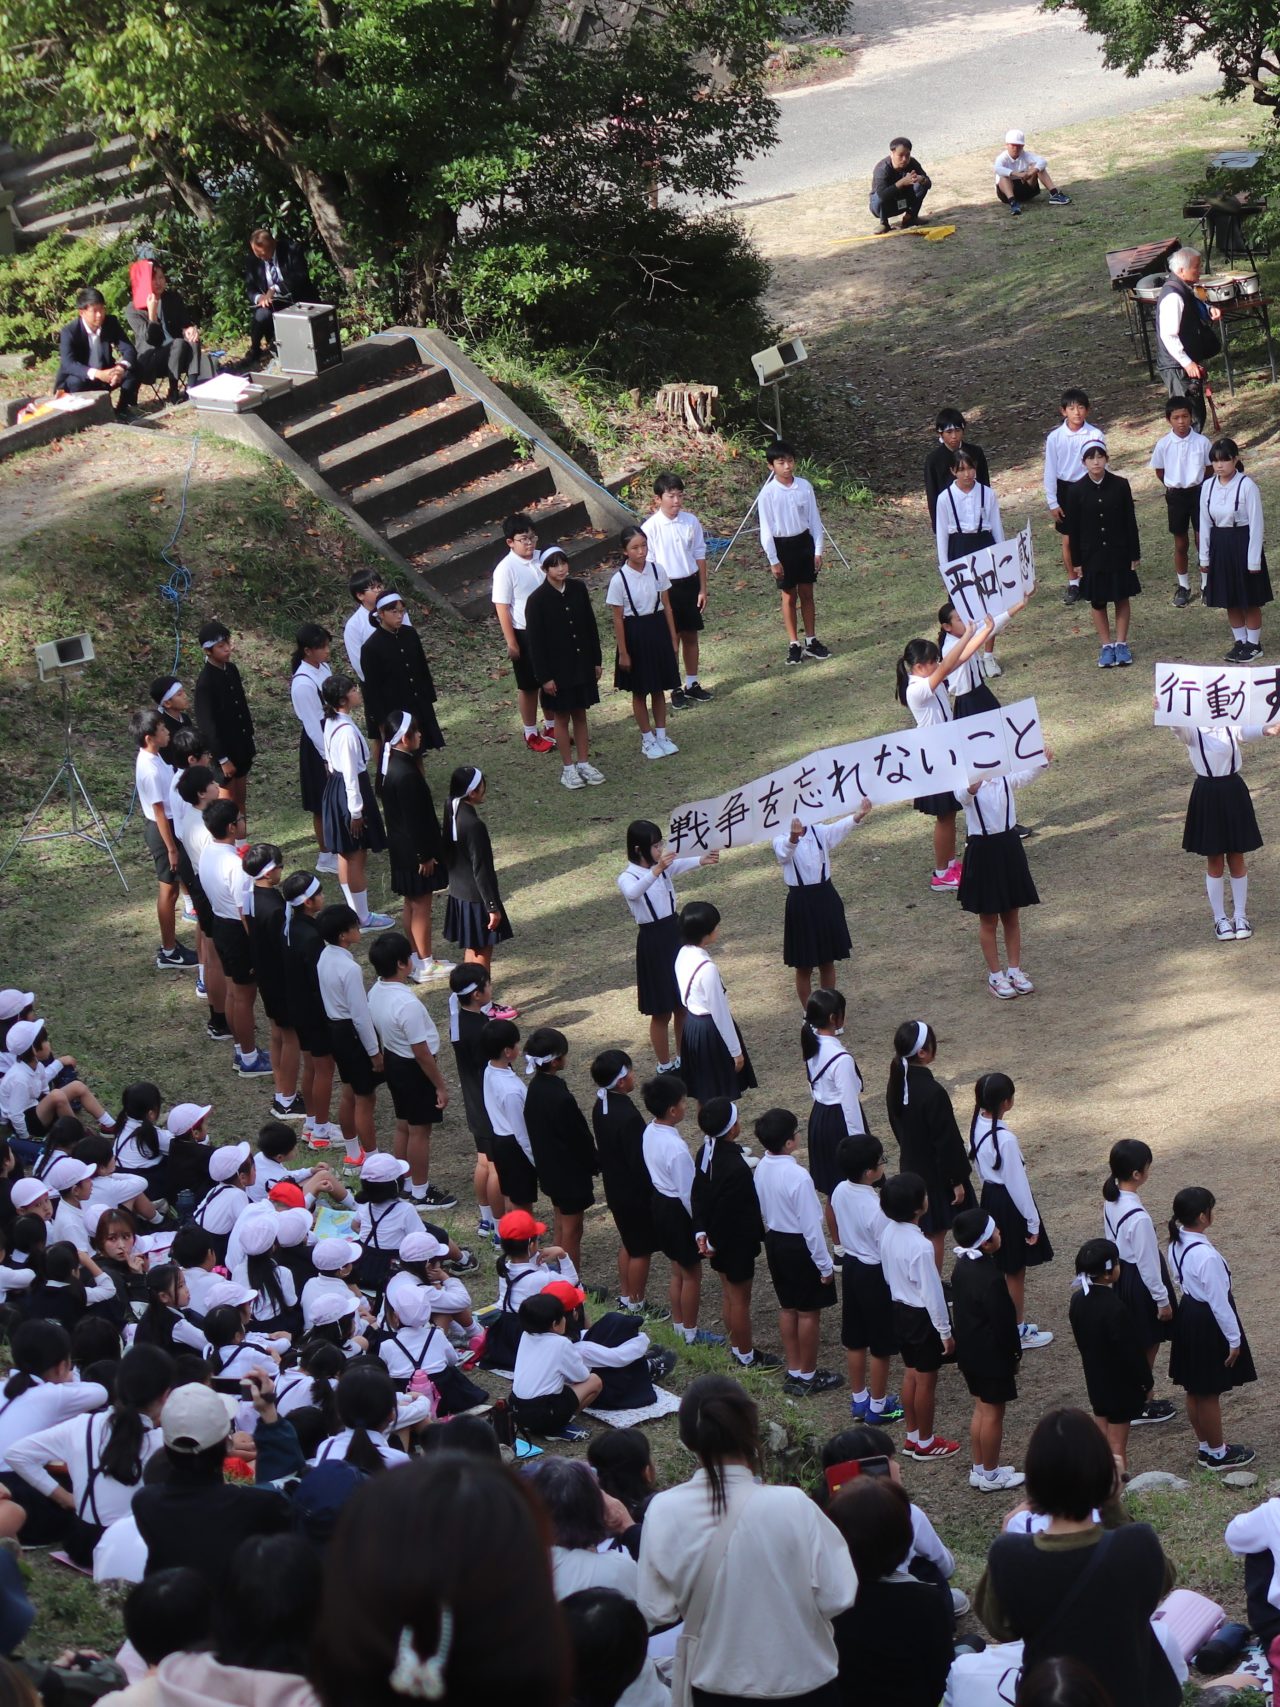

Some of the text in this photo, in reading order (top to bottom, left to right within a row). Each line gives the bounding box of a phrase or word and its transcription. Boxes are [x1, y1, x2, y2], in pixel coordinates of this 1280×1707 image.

[668, 716, 1044, 854] 戦争を忘れないこと
